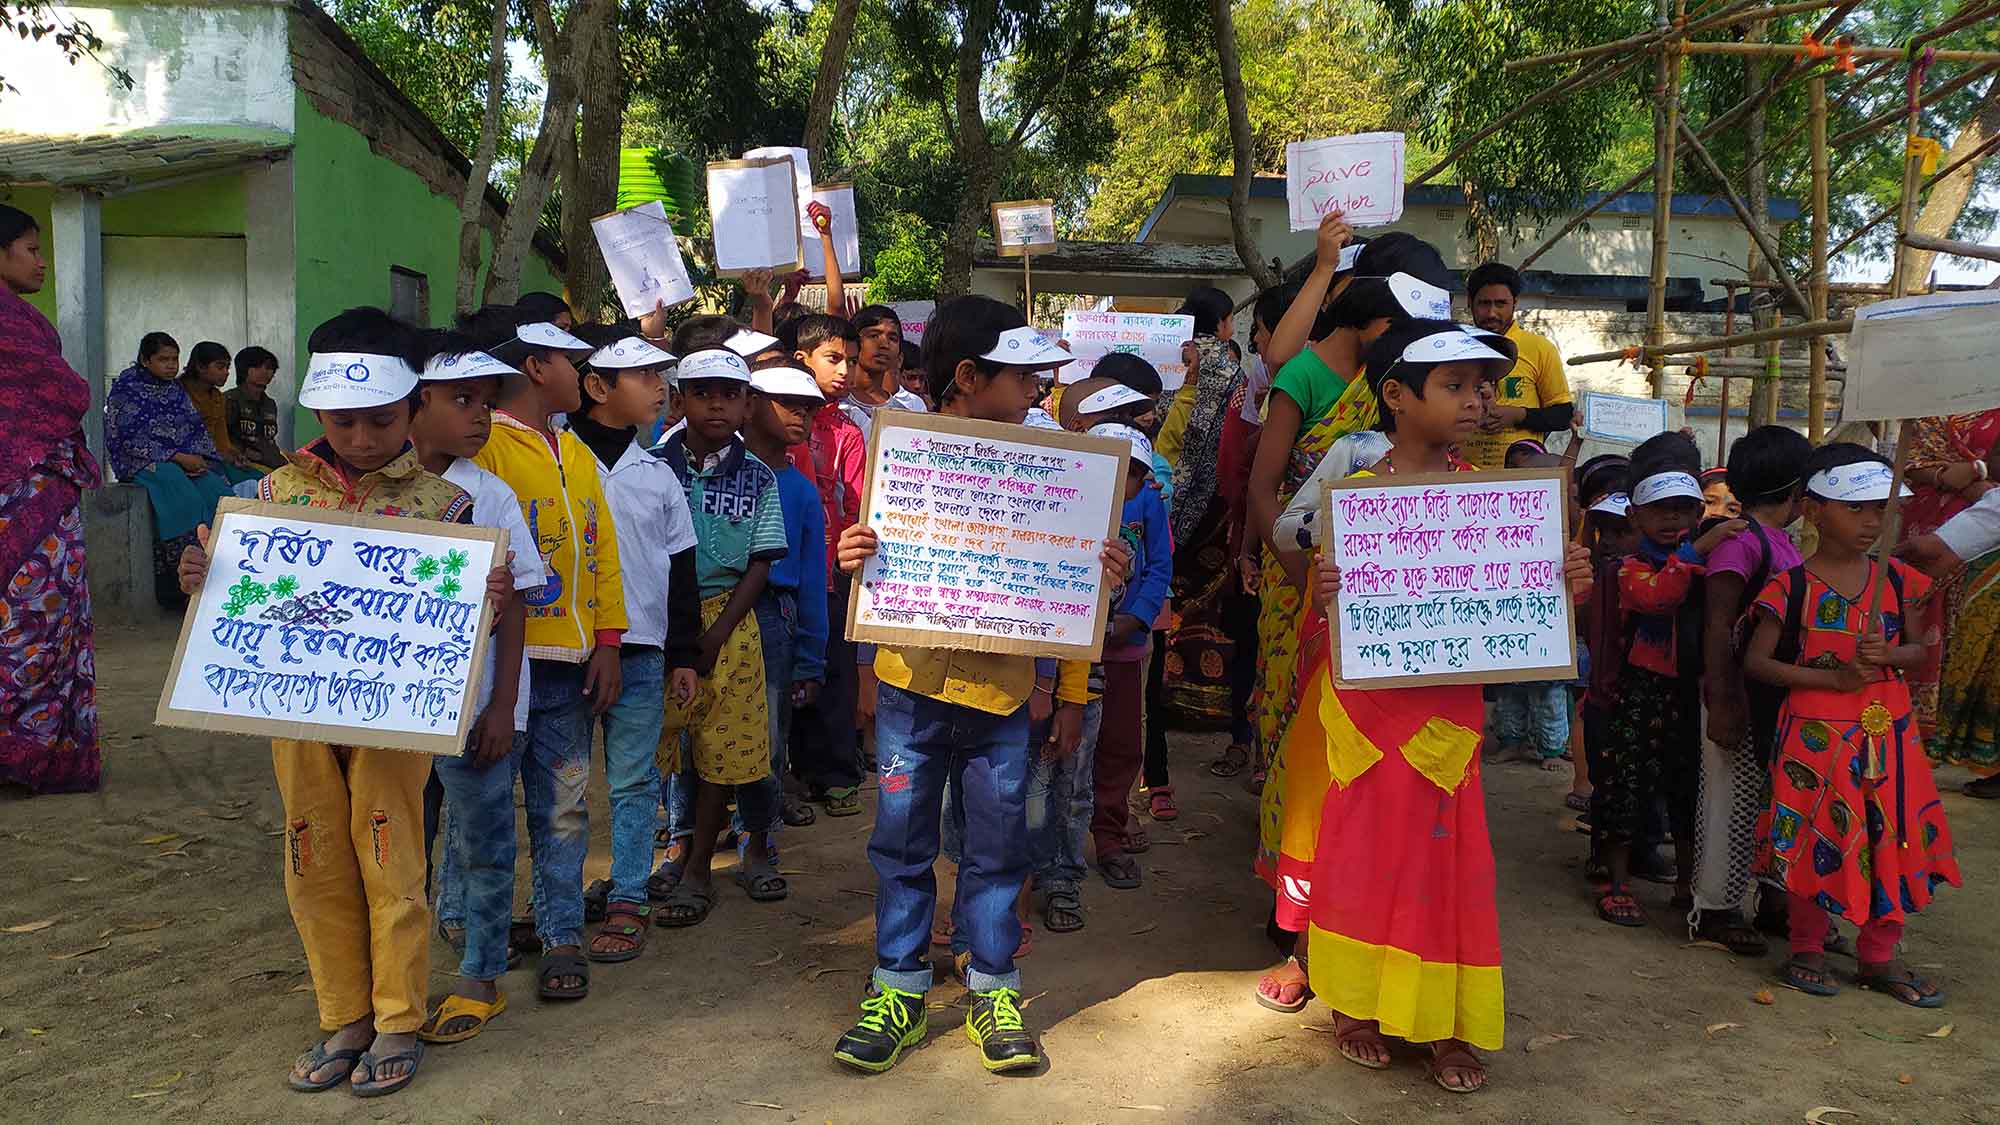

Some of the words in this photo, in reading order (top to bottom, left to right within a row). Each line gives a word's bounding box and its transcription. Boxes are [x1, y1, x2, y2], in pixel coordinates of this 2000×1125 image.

[1302, 161, 1372, 195] Save
[890, 463, 934, 482] আমাদের
[891, 448, 923, 464] আমরা
[888, 480, 925, 494] যেখানে
[931, 485, 966, 500] সেখানে
[885, 495, 927, 511] অন্যকে
[934, 501, 973, 516] ফেলতে
[978, 507, 1008, 521] দেবো
[1339, 493, 1394, 527] টেকসই
[1391, 496, 1420, 526] ব্যাগ
[1423, 489, 1452, 522] নিয়ে
[1456, 491, 1504, 520] বাজারে
[1344, 533, 1383, 557] রাক্ষস
[1387, 523, 1446, 560] পলিব্যাগ
[1451, 520, 1488, 554] বর্জন
[353, 541, 422, 587] বায়ু
[1345, 562, 1398, 594] প্লাস্টিক
[1402, 568, 1427, 598] মুক্ত
[1432, 563, 1479, 593] সমাজ
[1484, 562, 1511, 590] গড়ে
[320, 580, 414, 623] কমায়
[1496, 593, 1525, 623] গর্জে
[212, 617, 272, 669] বায়ু
[353, 633, 412, 668] রোধ
[412, 641, 471, 676] করি
[1358, 643, 1392, 668] শব্দ
[1441, 637, 1472, 668] দূর
[204, 664, 328, 715] বাসযোগ্য
